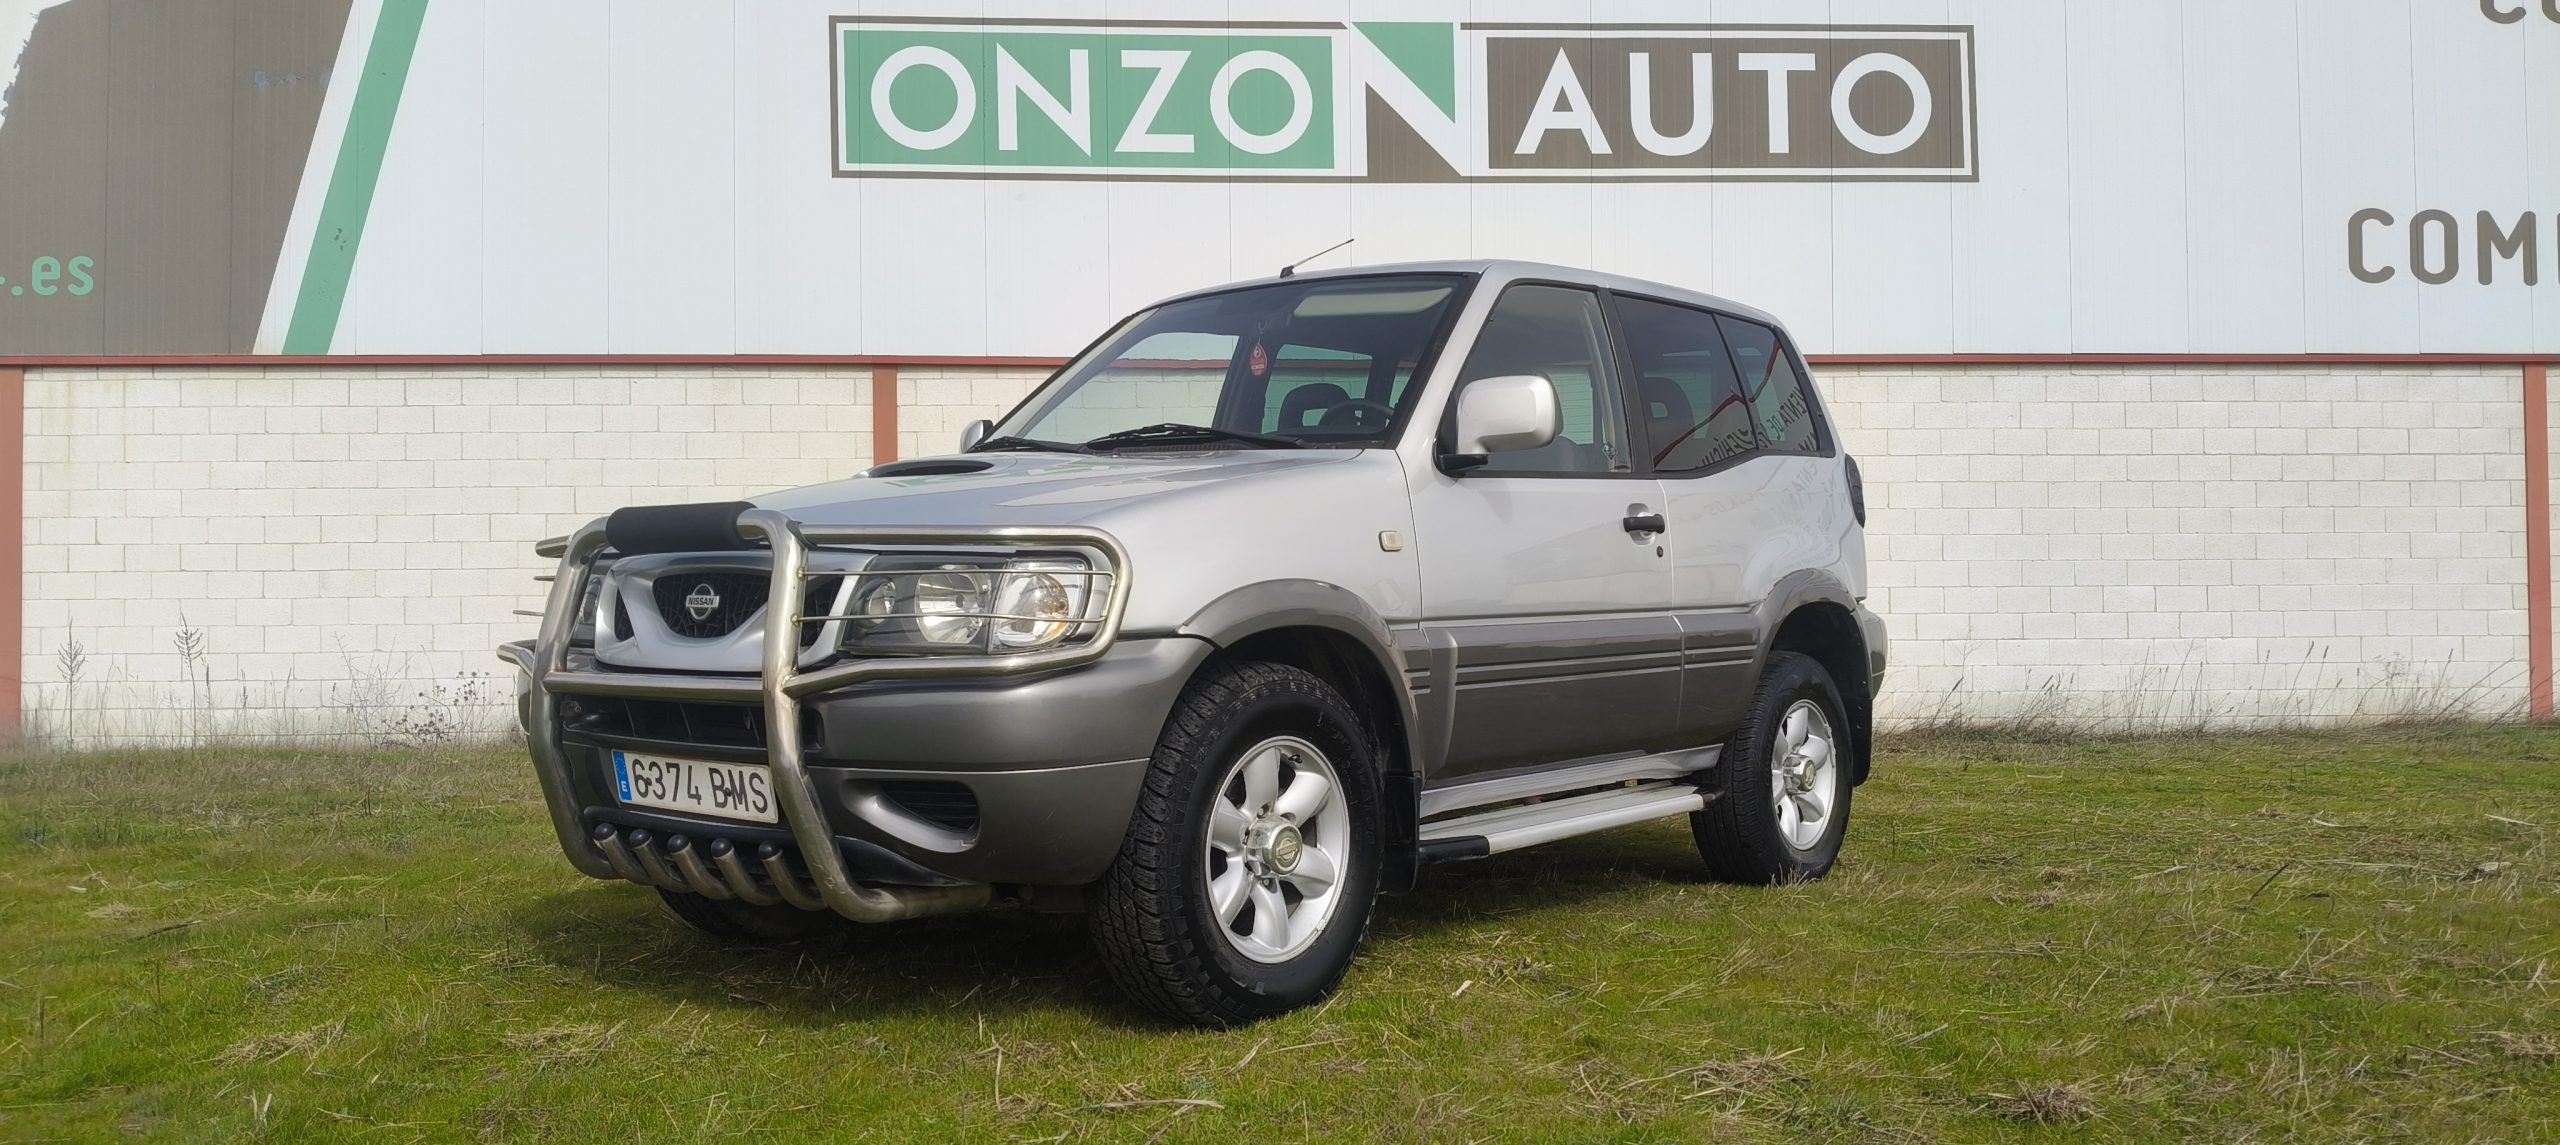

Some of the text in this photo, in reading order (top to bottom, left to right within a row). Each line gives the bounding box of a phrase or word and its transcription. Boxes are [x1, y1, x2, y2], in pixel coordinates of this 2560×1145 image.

[1513, 46, 1932, 156] AUTO
[2348, 208, 2560, 286] COM
[688, 597, 715, 606] NISSAN
[621, 758, 769, 814] E 6374 BMS
